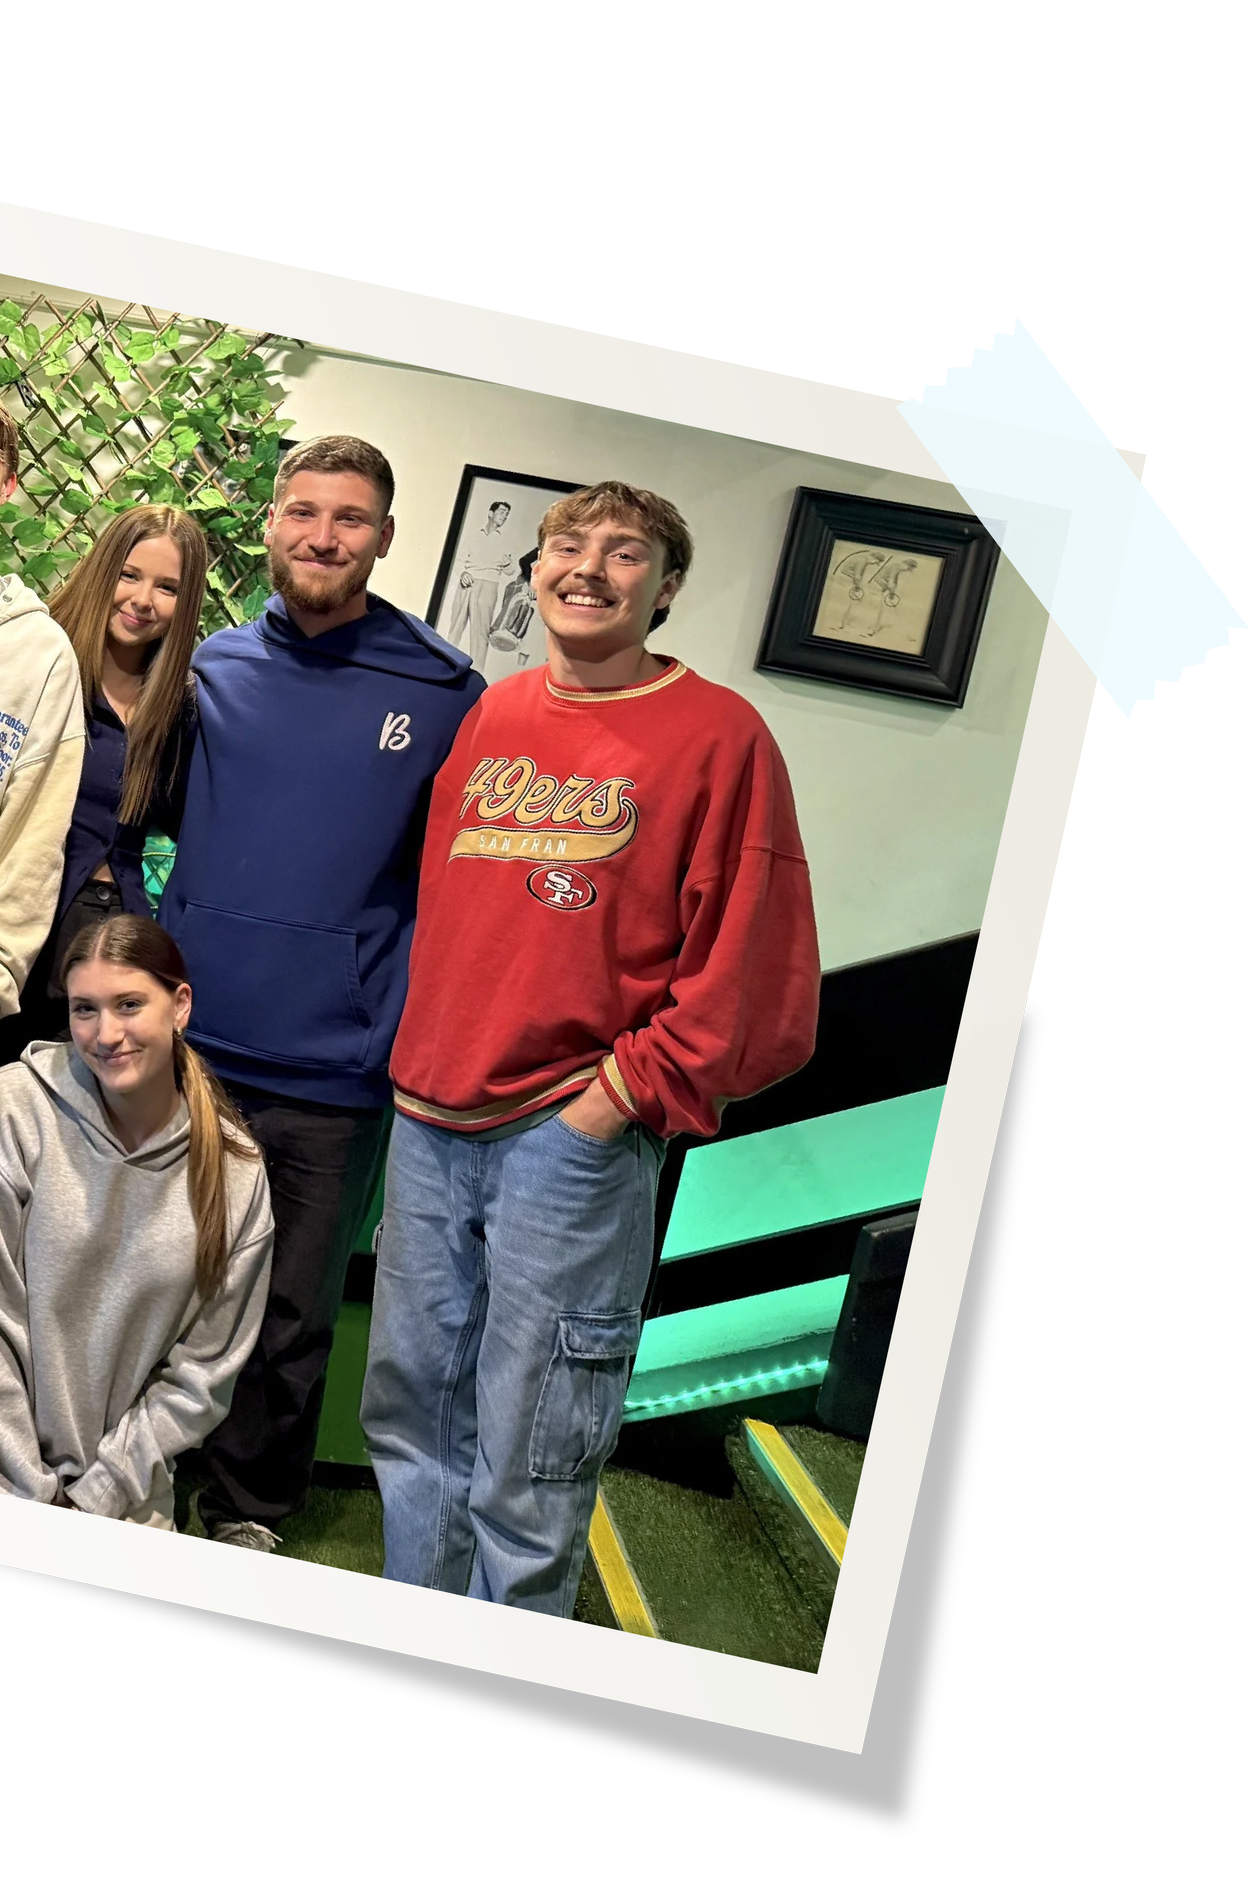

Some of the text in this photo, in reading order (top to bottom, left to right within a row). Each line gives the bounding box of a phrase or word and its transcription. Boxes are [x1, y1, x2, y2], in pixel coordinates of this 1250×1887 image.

[8, 732, 20, 750] To
[378, 712, 412, 751] B
[459, 756, 634, 828] 49ers
[479, 834, 568, 856] SAN FRAN
[544, 870, 583, 906] SF
